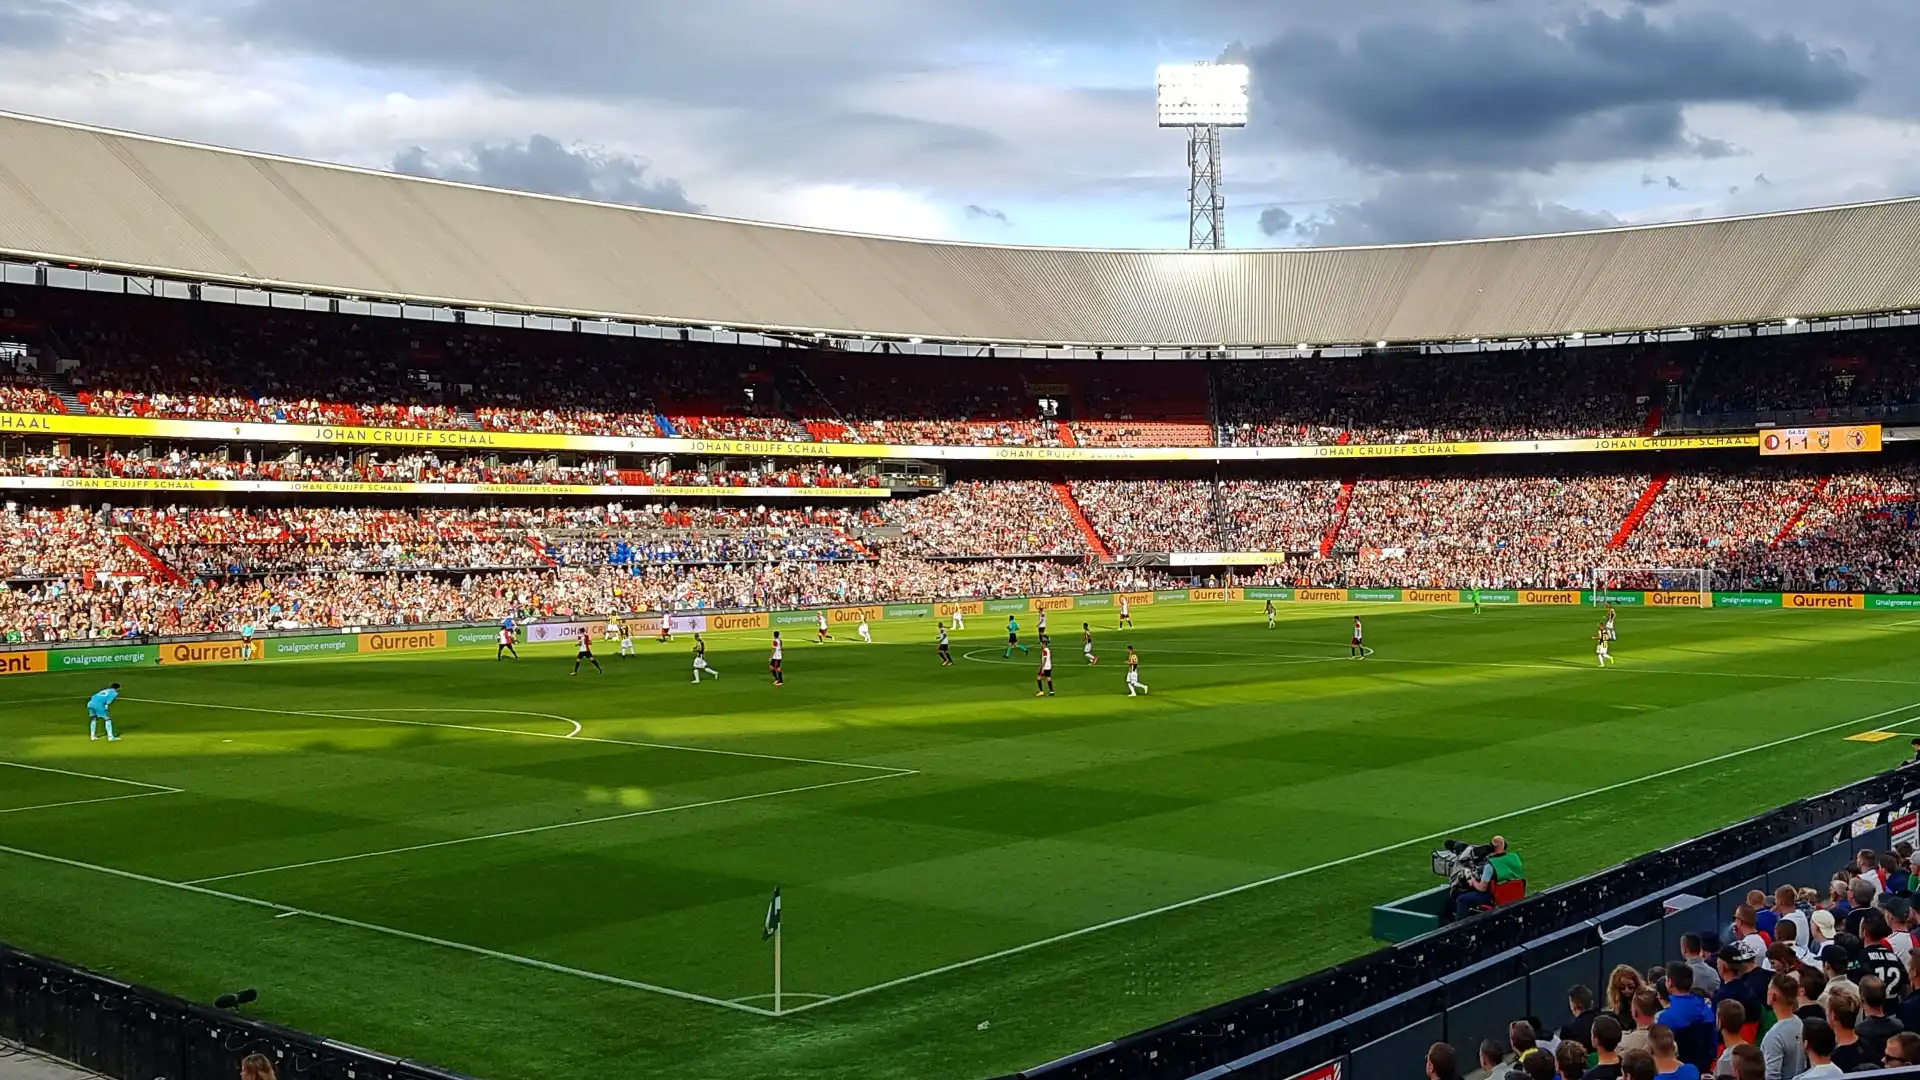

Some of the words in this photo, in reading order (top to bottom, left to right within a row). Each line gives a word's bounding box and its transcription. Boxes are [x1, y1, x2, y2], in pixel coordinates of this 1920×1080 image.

[315, 428, 366, 441] JOHAN
[373, 430, 432, 443] CRUIJFF
[440, 433, 495, 444] SCHAAL
[691, 442, 730, 451] JOHAN
[736, 443, 782, 453] CRUIJFF
[787, 444, 831, 454] SCHAAL
[1595, 440, 1637, 449] JOHAN
[1642, 438, 1693, 448] CRUIJFF
[1699, 437, 1749, 446] SCHAAL
[996, 450, 1033, 458] JOHAN
[1314, 447, 1354, 456] JOHAN
[1359, 446, 1406, 455] CRUIJFF
[1412, 445, 1458, 454] SCHAAL
[61, 479, 99, 488] JOHAN
[104, 480, 149, 488] CRUIJFF
[154, 480, 195, 489] SCHAAL
[326, 483, 365, 491] CRUIJFF
[368, 484, 404, 492] SCHAAL
[1300, 590, 1341, 600] Qurrent
[1409, 590, 1452, 601] Qurrent
[1526, 591, 1572, 603] Qurrent
[1792, 594, 1853, 607] Qurrent
[1035, 598, 1068, 610] Qurrent
[714, 616, 761, 629] Qurrent
[320, 641, 346, 651] energie
[370, 632, 435, 650] Qurrent
[114, 652, 145, 664] energie
[174, 645, 252, 661] Qurren
[1874, 966, 1901, 998] 12
